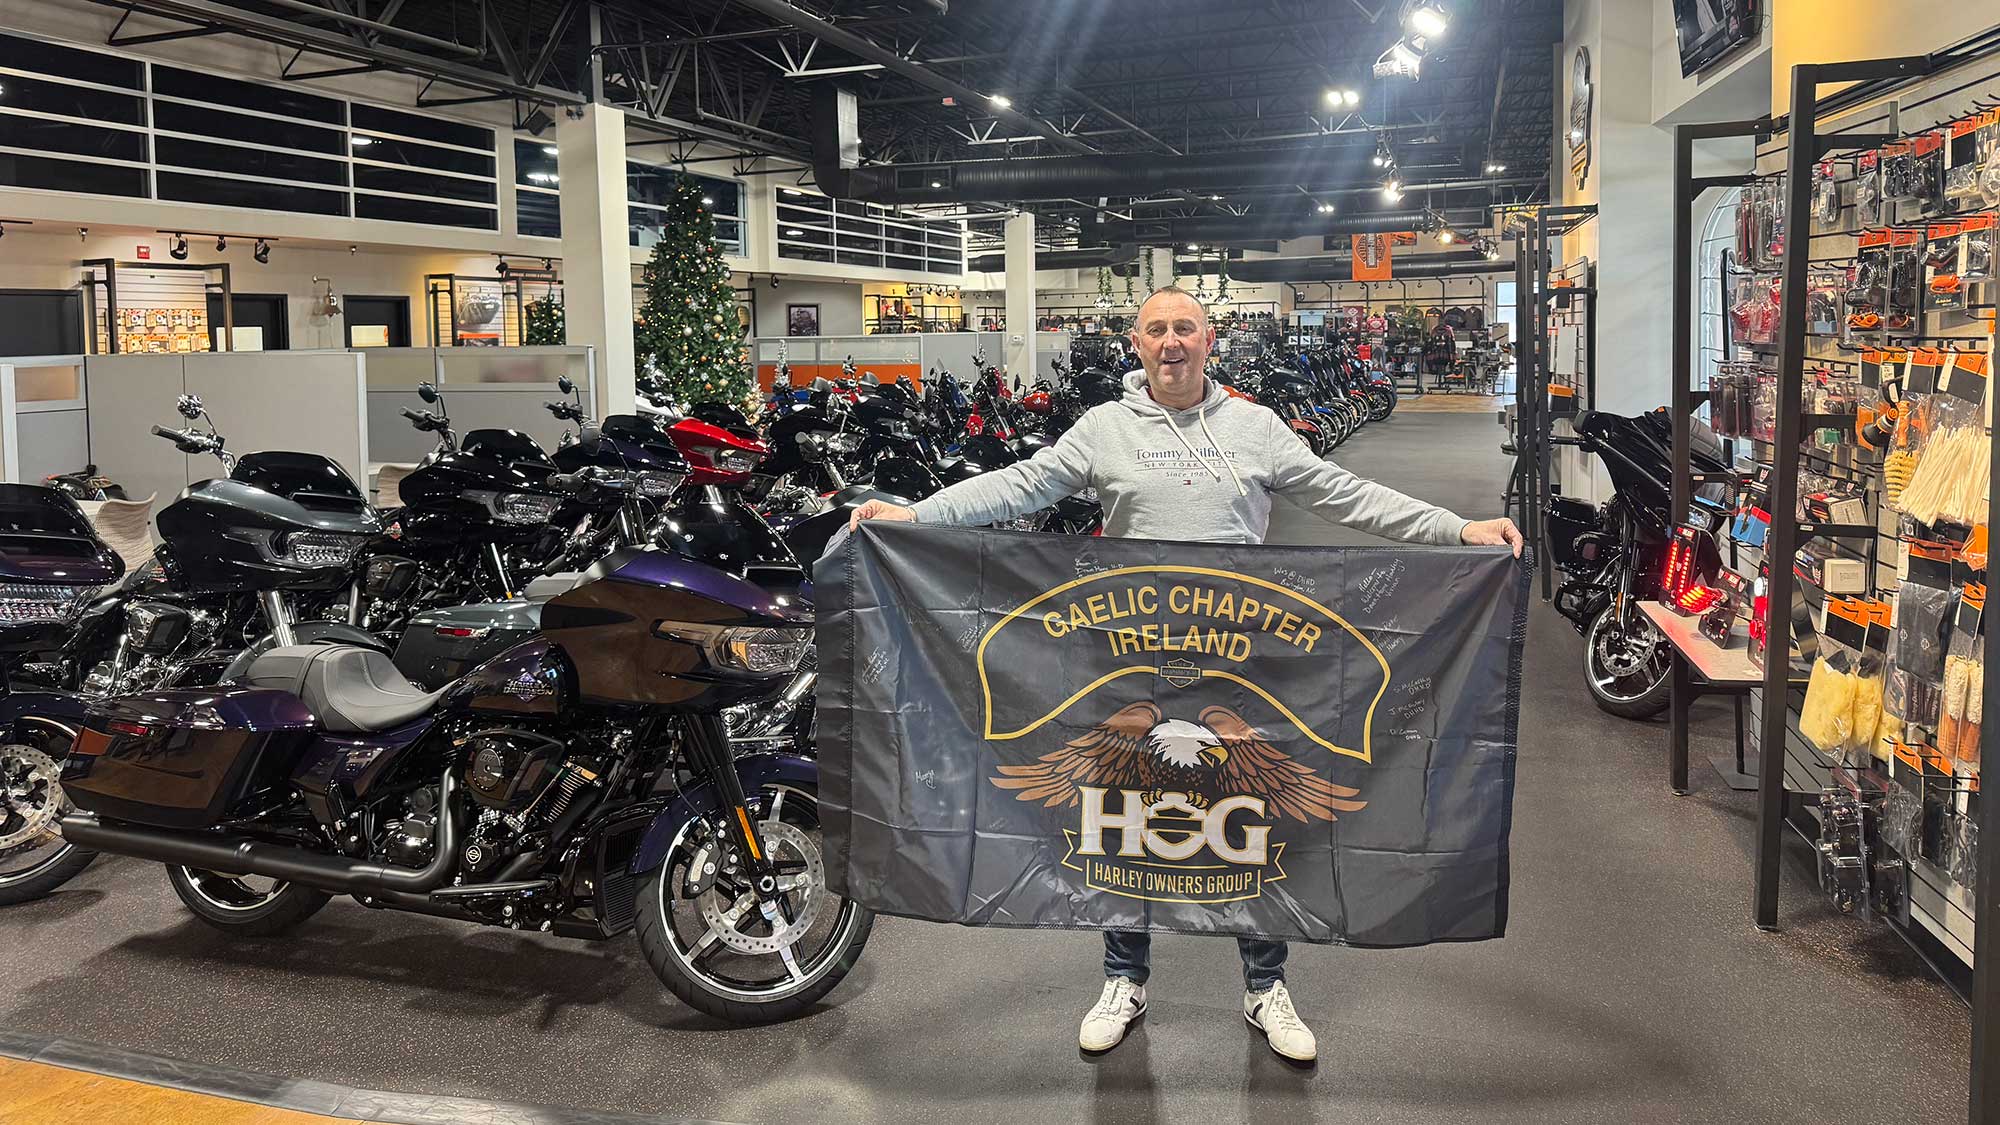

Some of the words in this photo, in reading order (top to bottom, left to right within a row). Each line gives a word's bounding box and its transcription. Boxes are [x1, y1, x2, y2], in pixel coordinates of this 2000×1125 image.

[1135, 449, 1183, 460] Tommy
[1043, 586, 1158, 638] GAELIC
[1168, 585, 1322, 653] CHAPTER
[1107, 624, 1252, 662] IRELAND
[1076, 786, 1272, 865] HOG
[1095, 862, 1143, 889] HARLEY
[1146, 872, 1203, 894] OWNERS
[1207, 872, 1252, 895] GROUP
